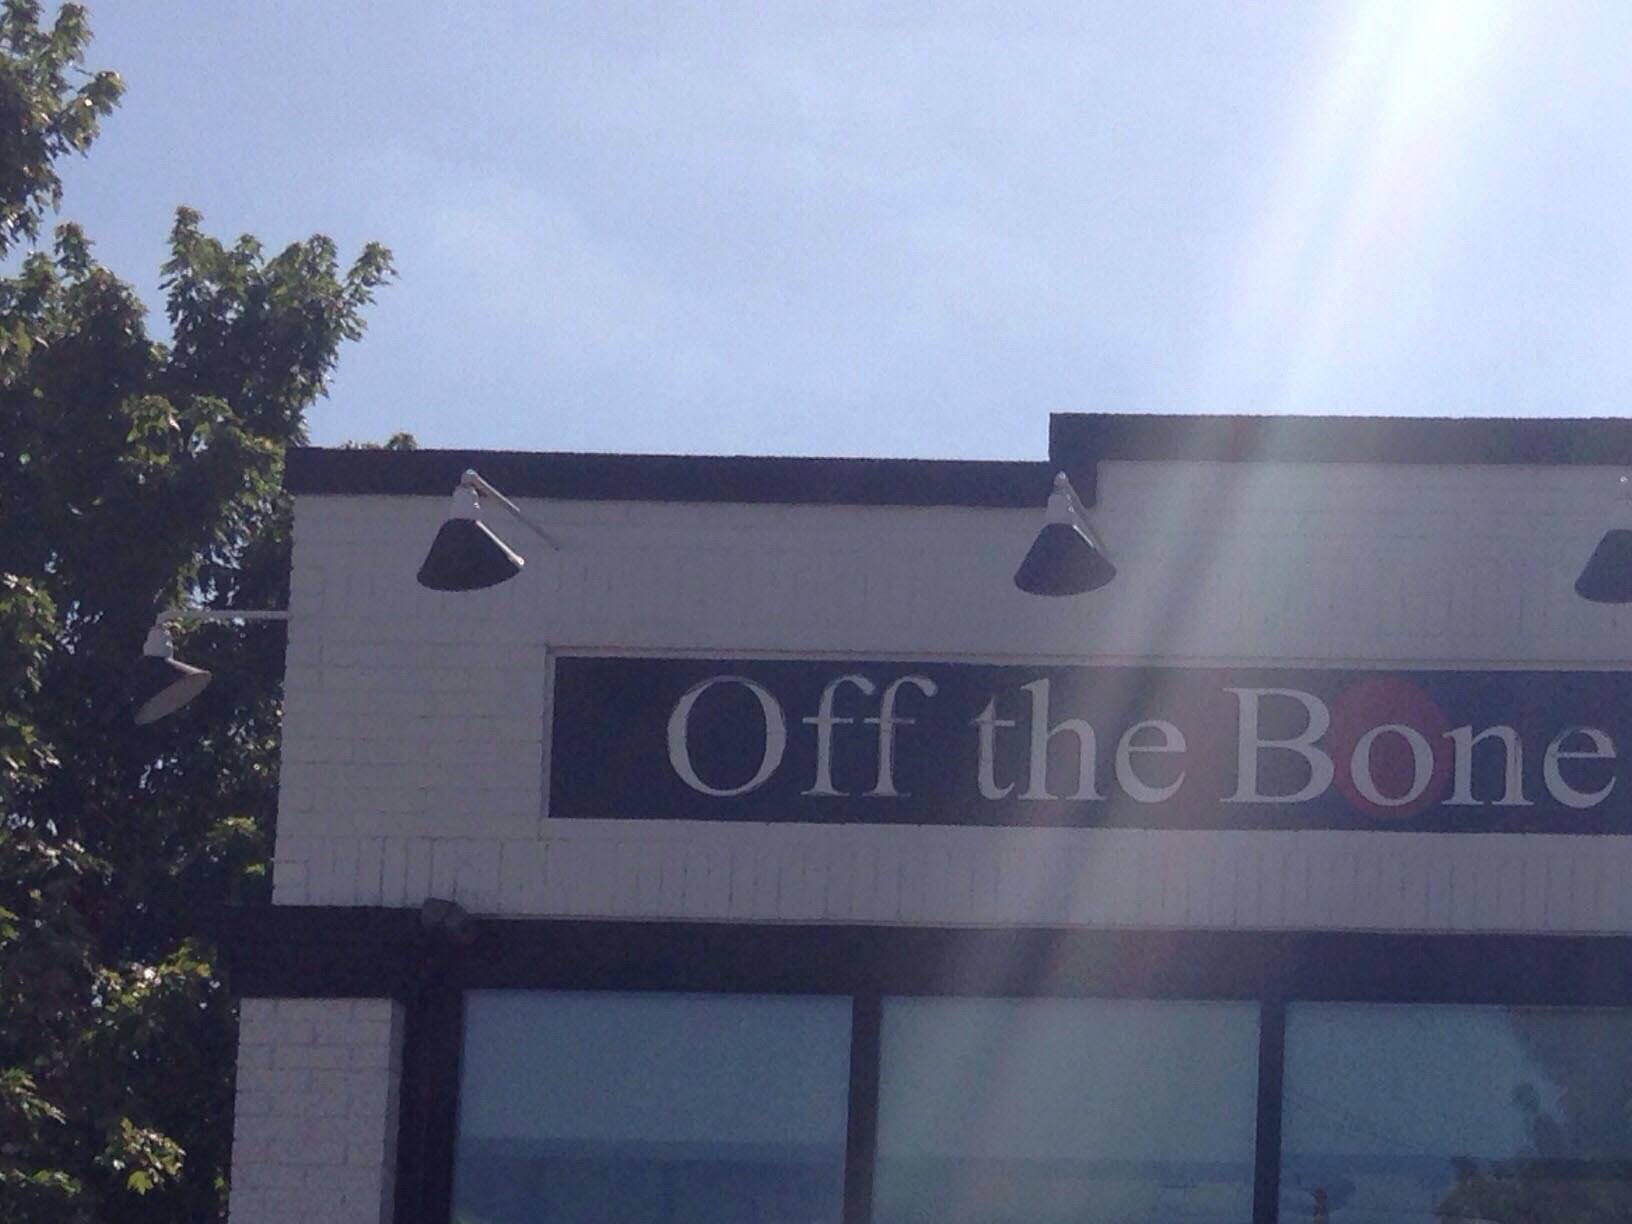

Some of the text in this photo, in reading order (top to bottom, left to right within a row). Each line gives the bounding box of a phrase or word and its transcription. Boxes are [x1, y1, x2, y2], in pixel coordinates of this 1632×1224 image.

[665, 673, 938, 797] Off
[970, 677, 1188, 801] the
[1218, 686, 1618, 808] Bone
